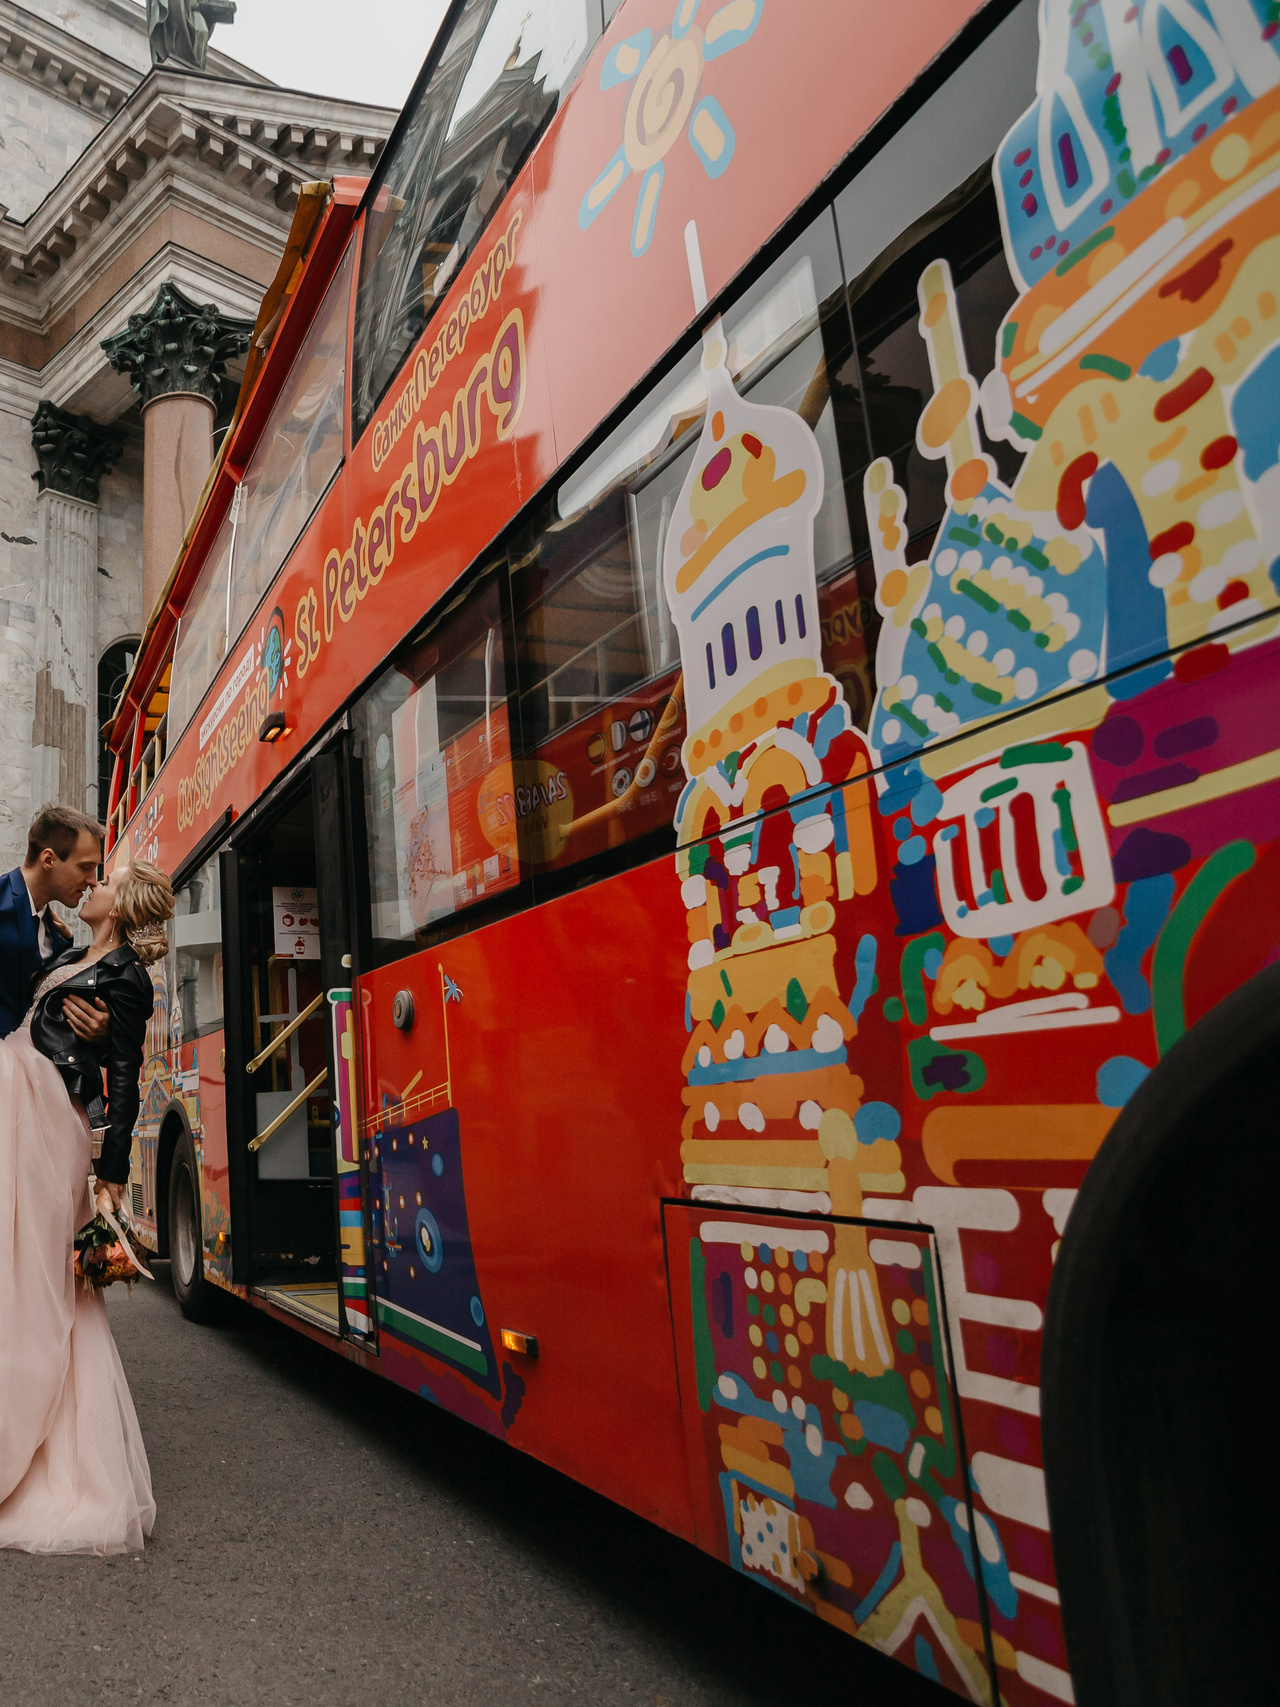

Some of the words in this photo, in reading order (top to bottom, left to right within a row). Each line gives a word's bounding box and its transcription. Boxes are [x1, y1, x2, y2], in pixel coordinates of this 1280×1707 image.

[295, 586, 320, 678] St
[323, 308, 526, 643] Petersburg
[371, 209, 522, 473] Санкт-Петербург
